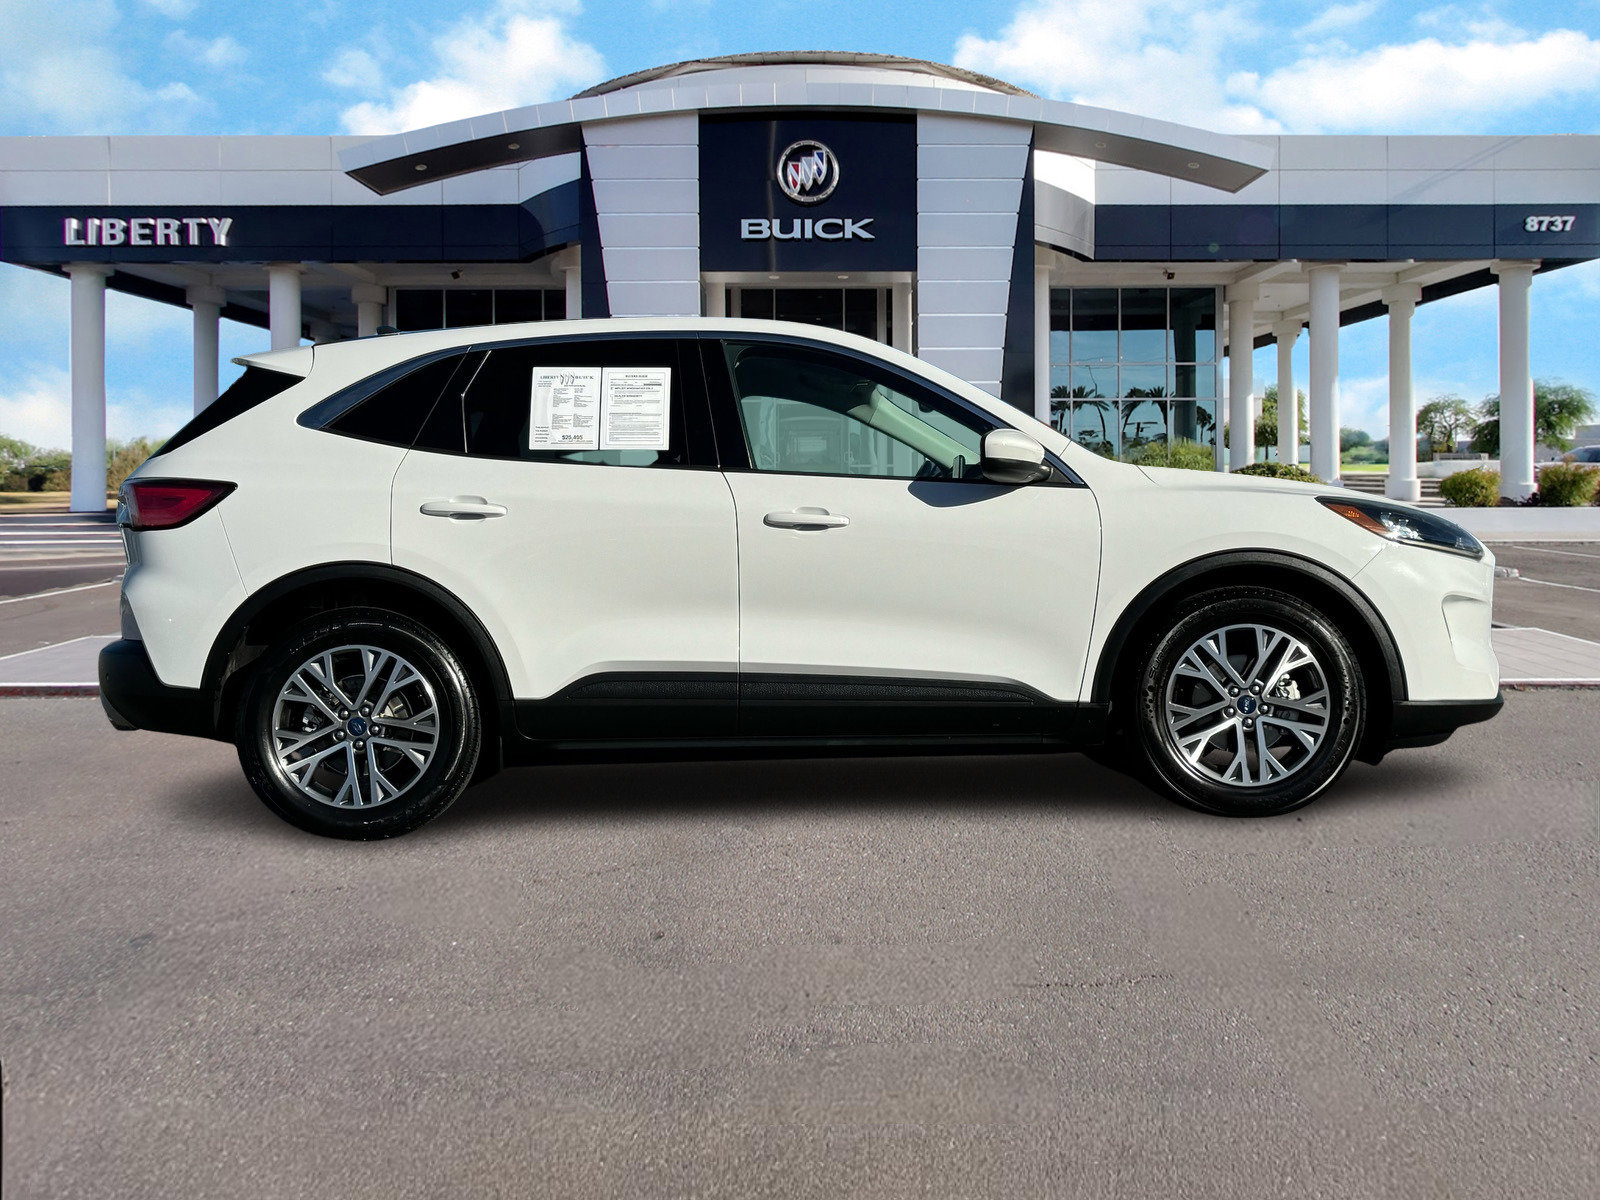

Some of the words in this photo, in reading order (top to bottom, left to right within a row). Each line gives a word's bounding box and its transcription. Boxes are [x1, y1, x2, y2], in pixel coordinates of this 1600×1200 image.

[64, 217, 233, 246] LIBERTY
[741, 218, 875, 239] BUICK
[1525, 216, 1576, 231] 8737
